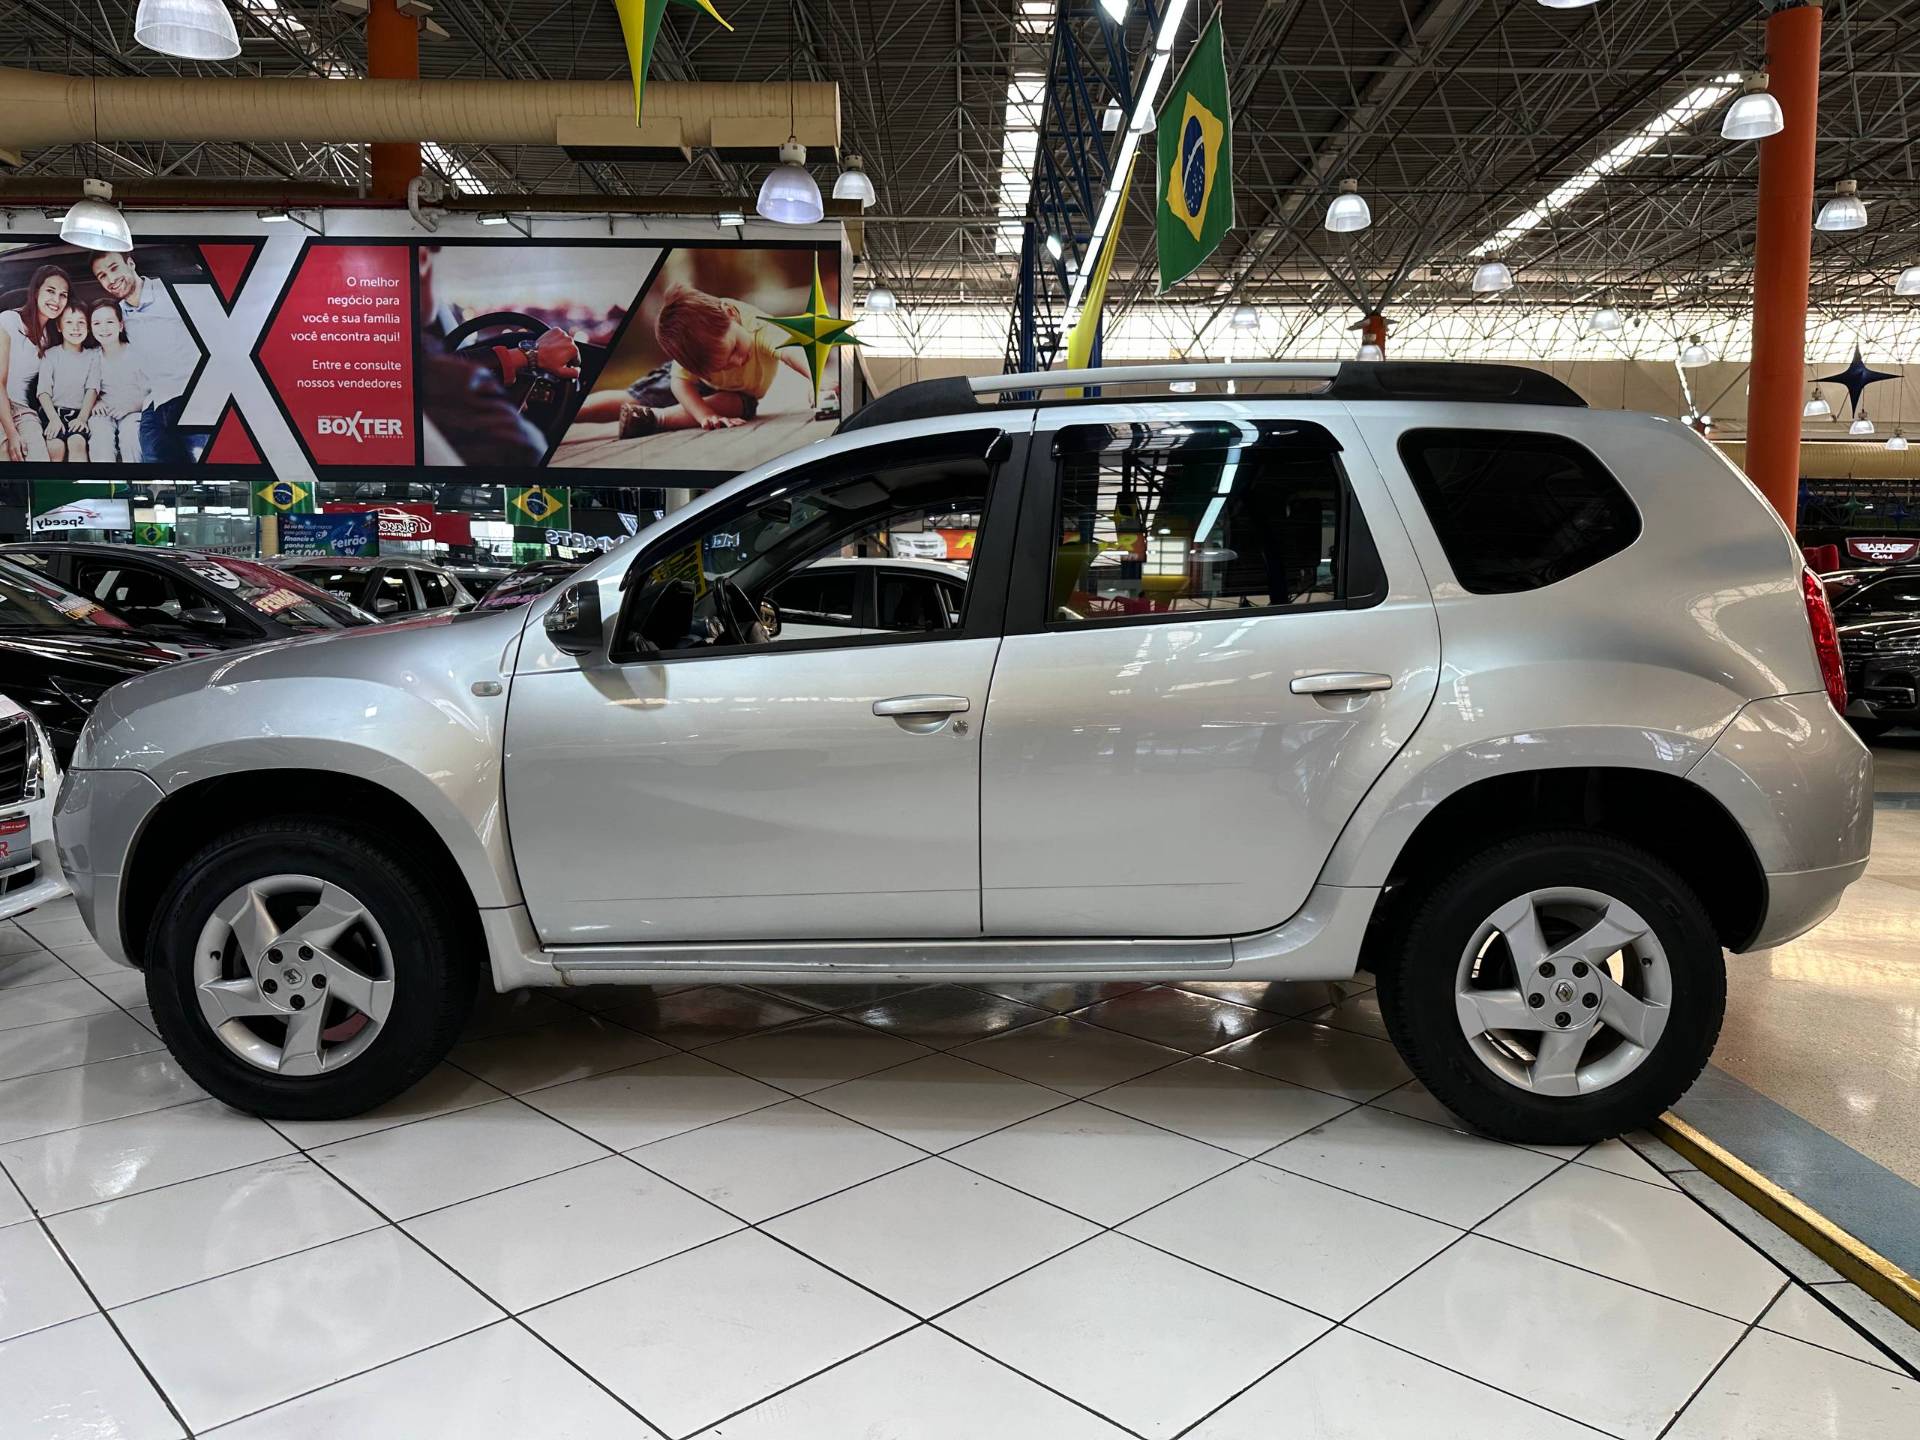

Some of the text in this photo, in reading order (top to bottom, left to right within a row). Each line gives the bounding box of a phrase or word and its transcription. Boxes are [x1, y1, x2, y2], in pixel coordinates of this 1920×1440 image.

[346, 276, 400, 287] O melhor
[327, 294, 400, 307] negócio para
[302, 312, 401, 324] você e sua família
[291, 330, 401, 344] você encontra aqui!
[312, 360, 402, 370] Entre e consulte
[297, 379, 402, 389] nossos vendedores
[317, 410, 403, 443] BOXTER
[330, 535, 368, 551] Feirão
